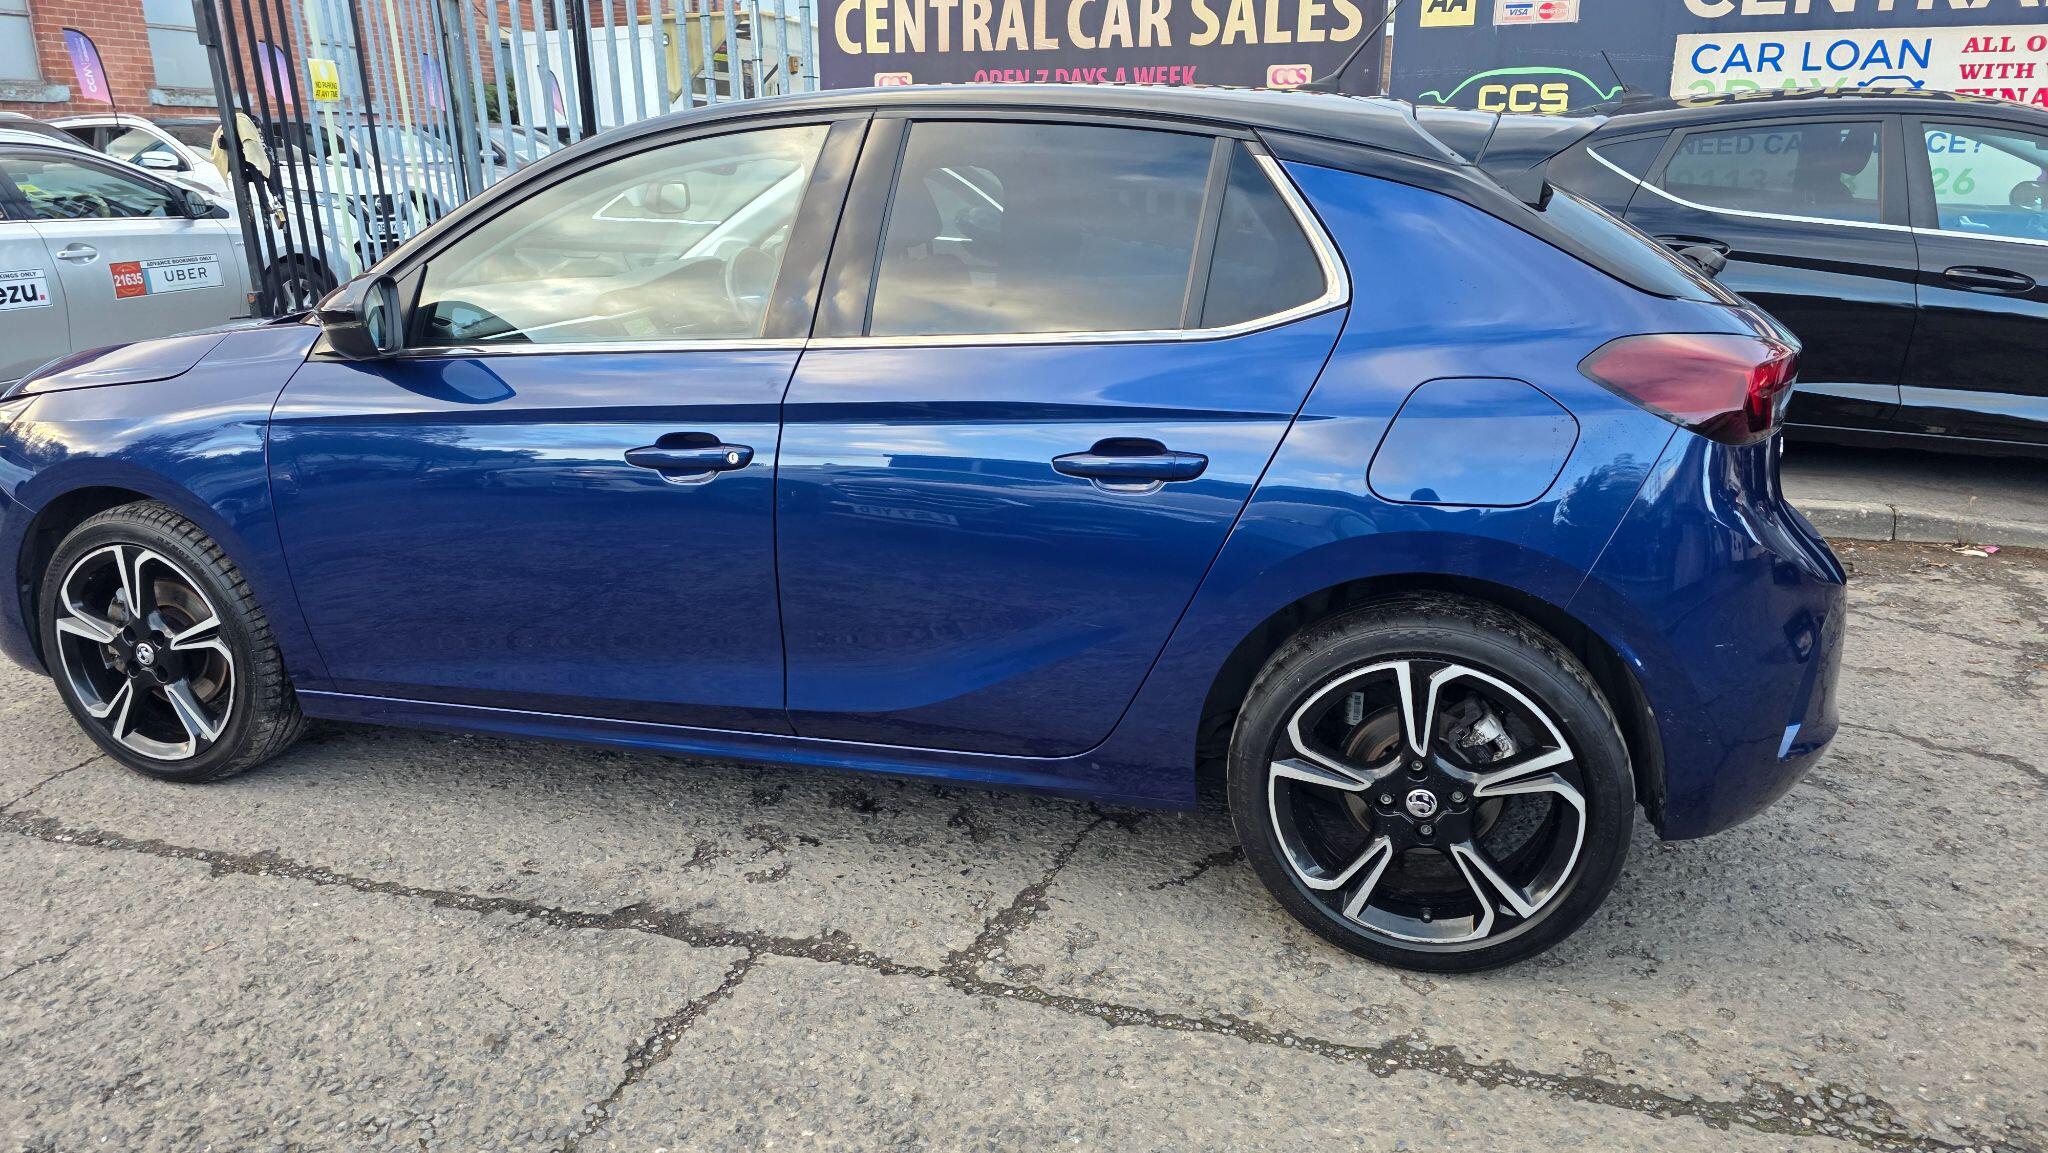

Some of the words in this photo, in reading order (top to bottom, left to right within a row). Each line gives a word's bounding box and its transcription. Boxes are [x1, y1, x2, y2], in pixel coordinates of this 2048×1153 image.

[835, 0, 1059, 54] CENTRAL
[1067, 0, 1172, 49] CAR
[1190, 0, 1363, 46] SALES
[1961, 37, 2016, 53] ALL
[1691, 42, 1785, 74] CAR
[1801, 38, 1932, 71] LOAN
[1959, 63, 2036, 79] WITH
[1478, 83, 1568, 113] CCS
[114, 272, 143, 287] 21635
[164, 267, 208, 282] UBER
